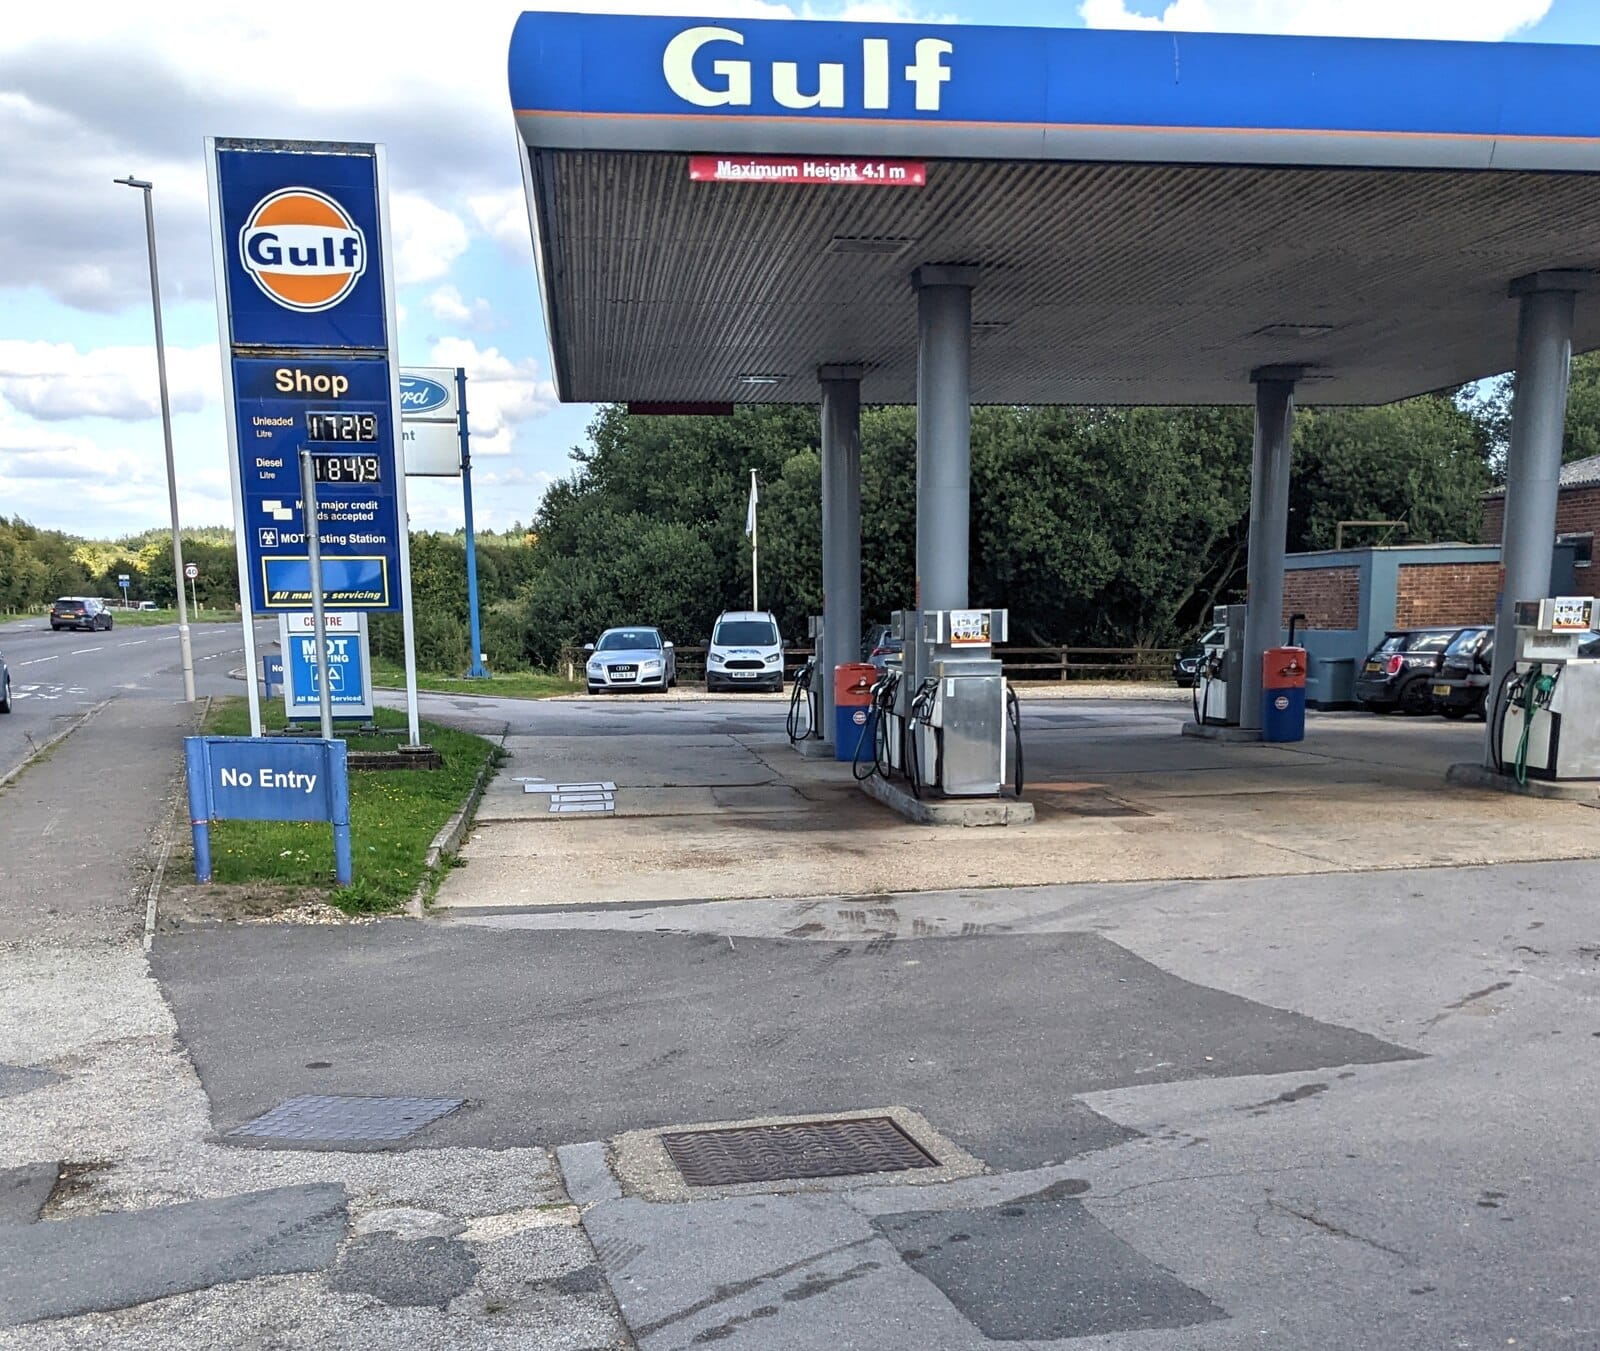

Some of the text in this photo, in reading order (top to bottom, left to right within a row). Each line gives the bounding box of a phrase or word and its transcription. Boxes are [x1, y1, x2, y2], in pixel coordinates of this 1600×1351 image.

[663, 26, 953, 111] Gulf
[717, 161, 905, 181] Maximum Height 4.1 m
[247, 232, 358, 267] Gulf
[275, 368, 349, 398] Shop
[252, 416, 294, 426] Unleaded
[256, 430, 273, 438] Litre
[256, 458, 283, 467] Diesel
[259, 471, 276, 479] Litre
[295, 500, 378, 511] Mt major credit
[331, 512, 374, 522] accepted
[280, 533, 386, 545] MOT sting Station
[272, 591, 381, 601] All maks servicing
[303, 616, 343, 627] CETRE
[303, 654, 349, 663] TEING
[272, 664, 283, 673] No
[221, 768, 317, 793] No Entry
